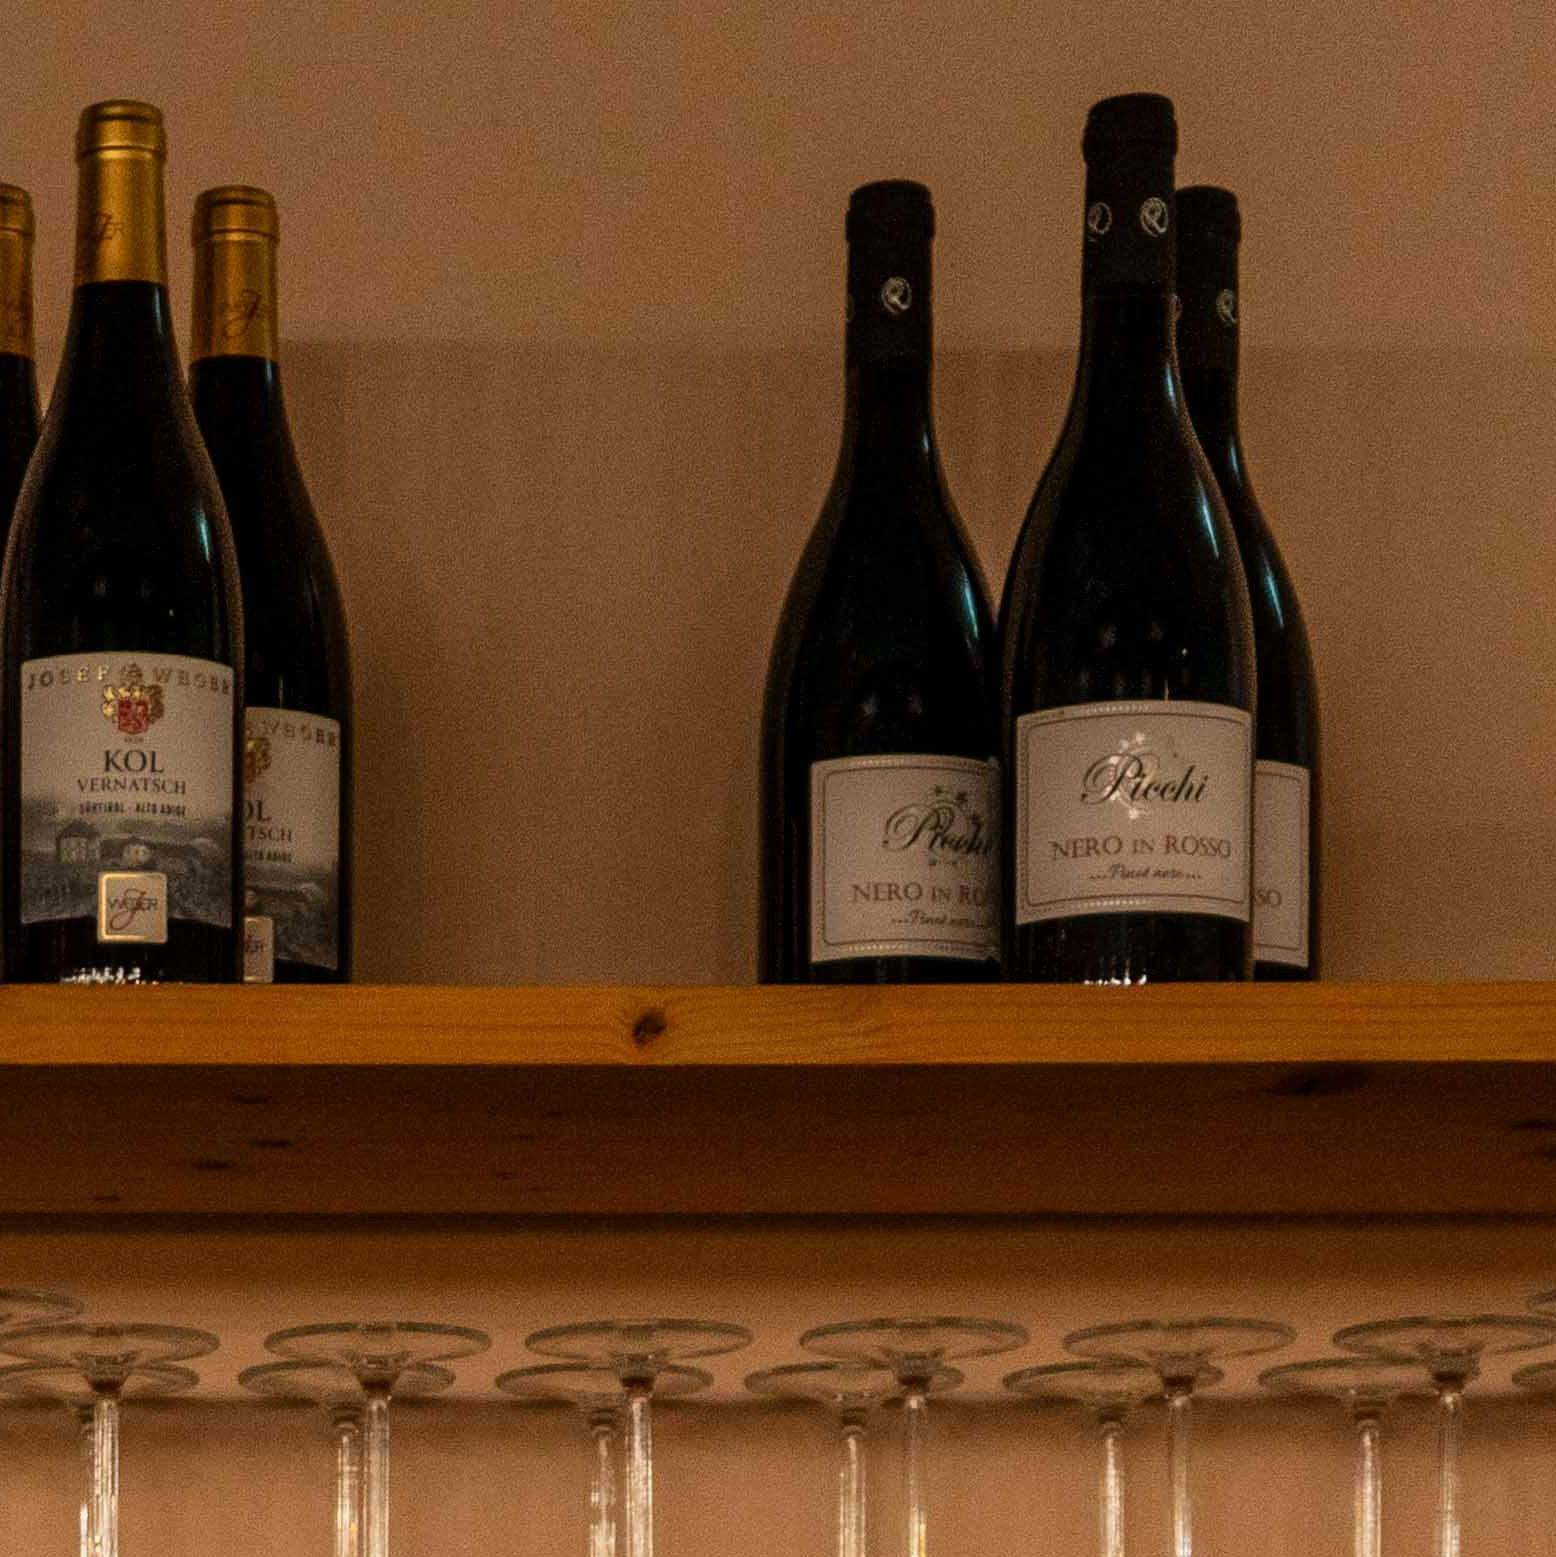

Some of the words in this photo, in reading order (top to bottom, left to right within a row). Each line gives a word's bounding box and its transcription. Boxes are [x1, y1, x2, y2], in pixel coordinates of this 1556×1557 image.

[27, 664, 110, 690] JOSEF
[104, 749, 165, 774] KOL
[76, 777, 187, 795] VERNATSCH
[1080, 752, 1208, 806] Picchi
[1048, 835, 1123, 861] NERO
[1132, 838, 1155, 855] IN
[1165, 834, 1232, 859] ROSSO
[852, 881, 923, 903] NERO
[930, 885, 951, 902] IN
